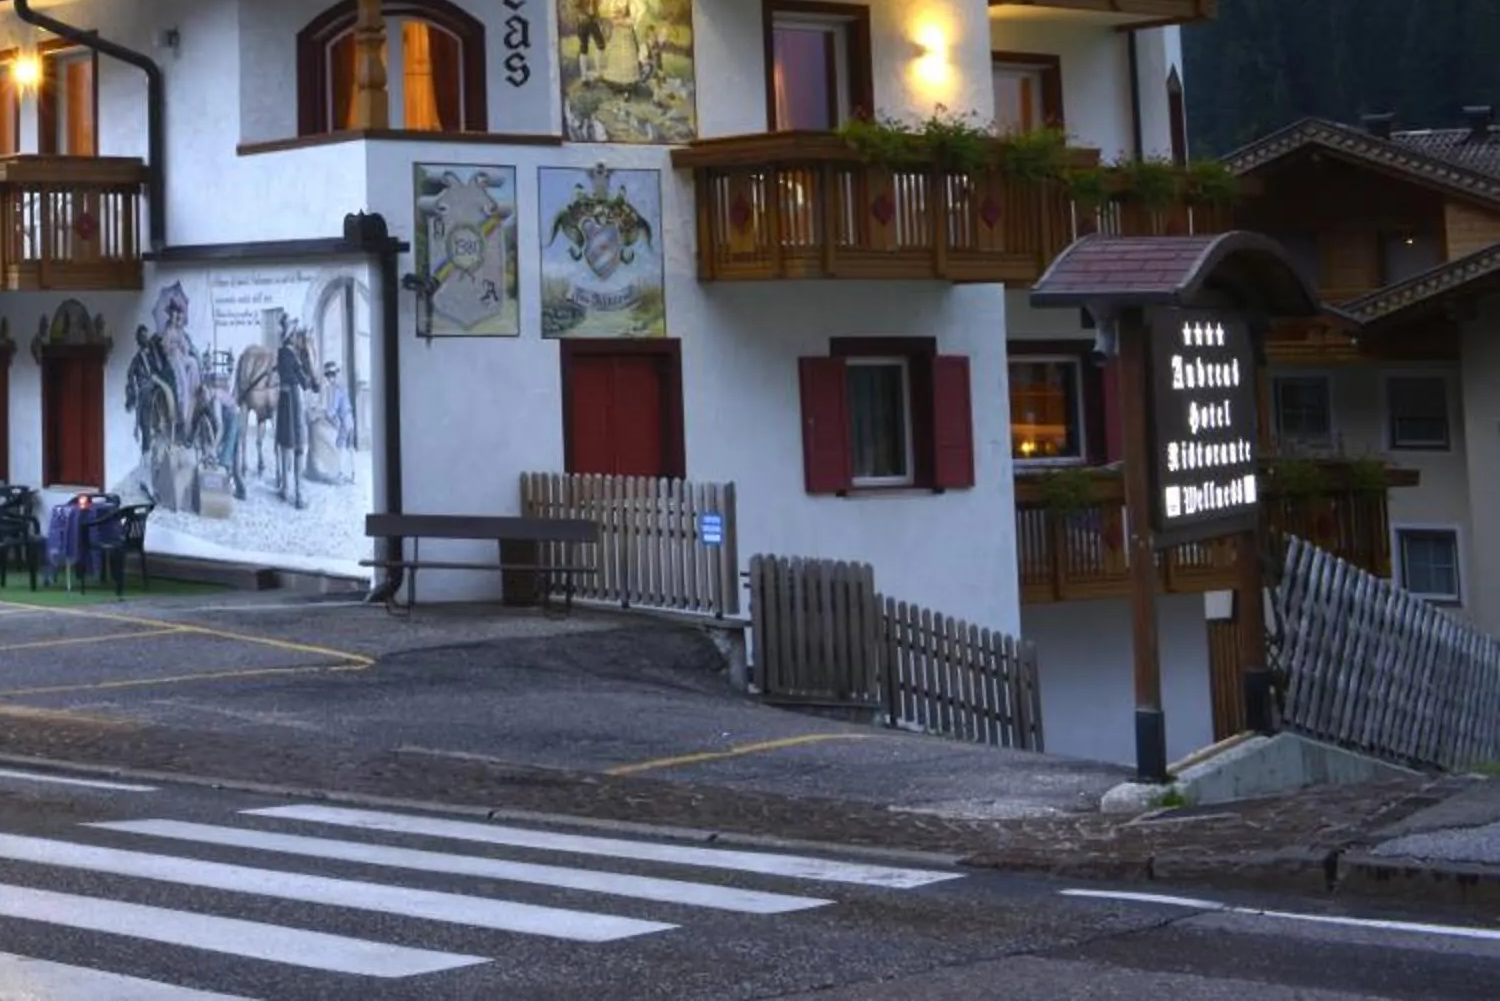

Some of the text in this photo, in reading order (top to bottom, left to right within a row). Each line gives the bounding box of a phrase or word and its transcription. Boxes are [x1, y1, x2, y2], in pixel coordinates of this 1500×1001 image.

[1171, 354, 1240, 390] Andreas
[1188, 400, 1231, 435] Hotel
[1167, 438, 1251, 472] Ristorante
[1183, 479, 1243, 515] Wellness
